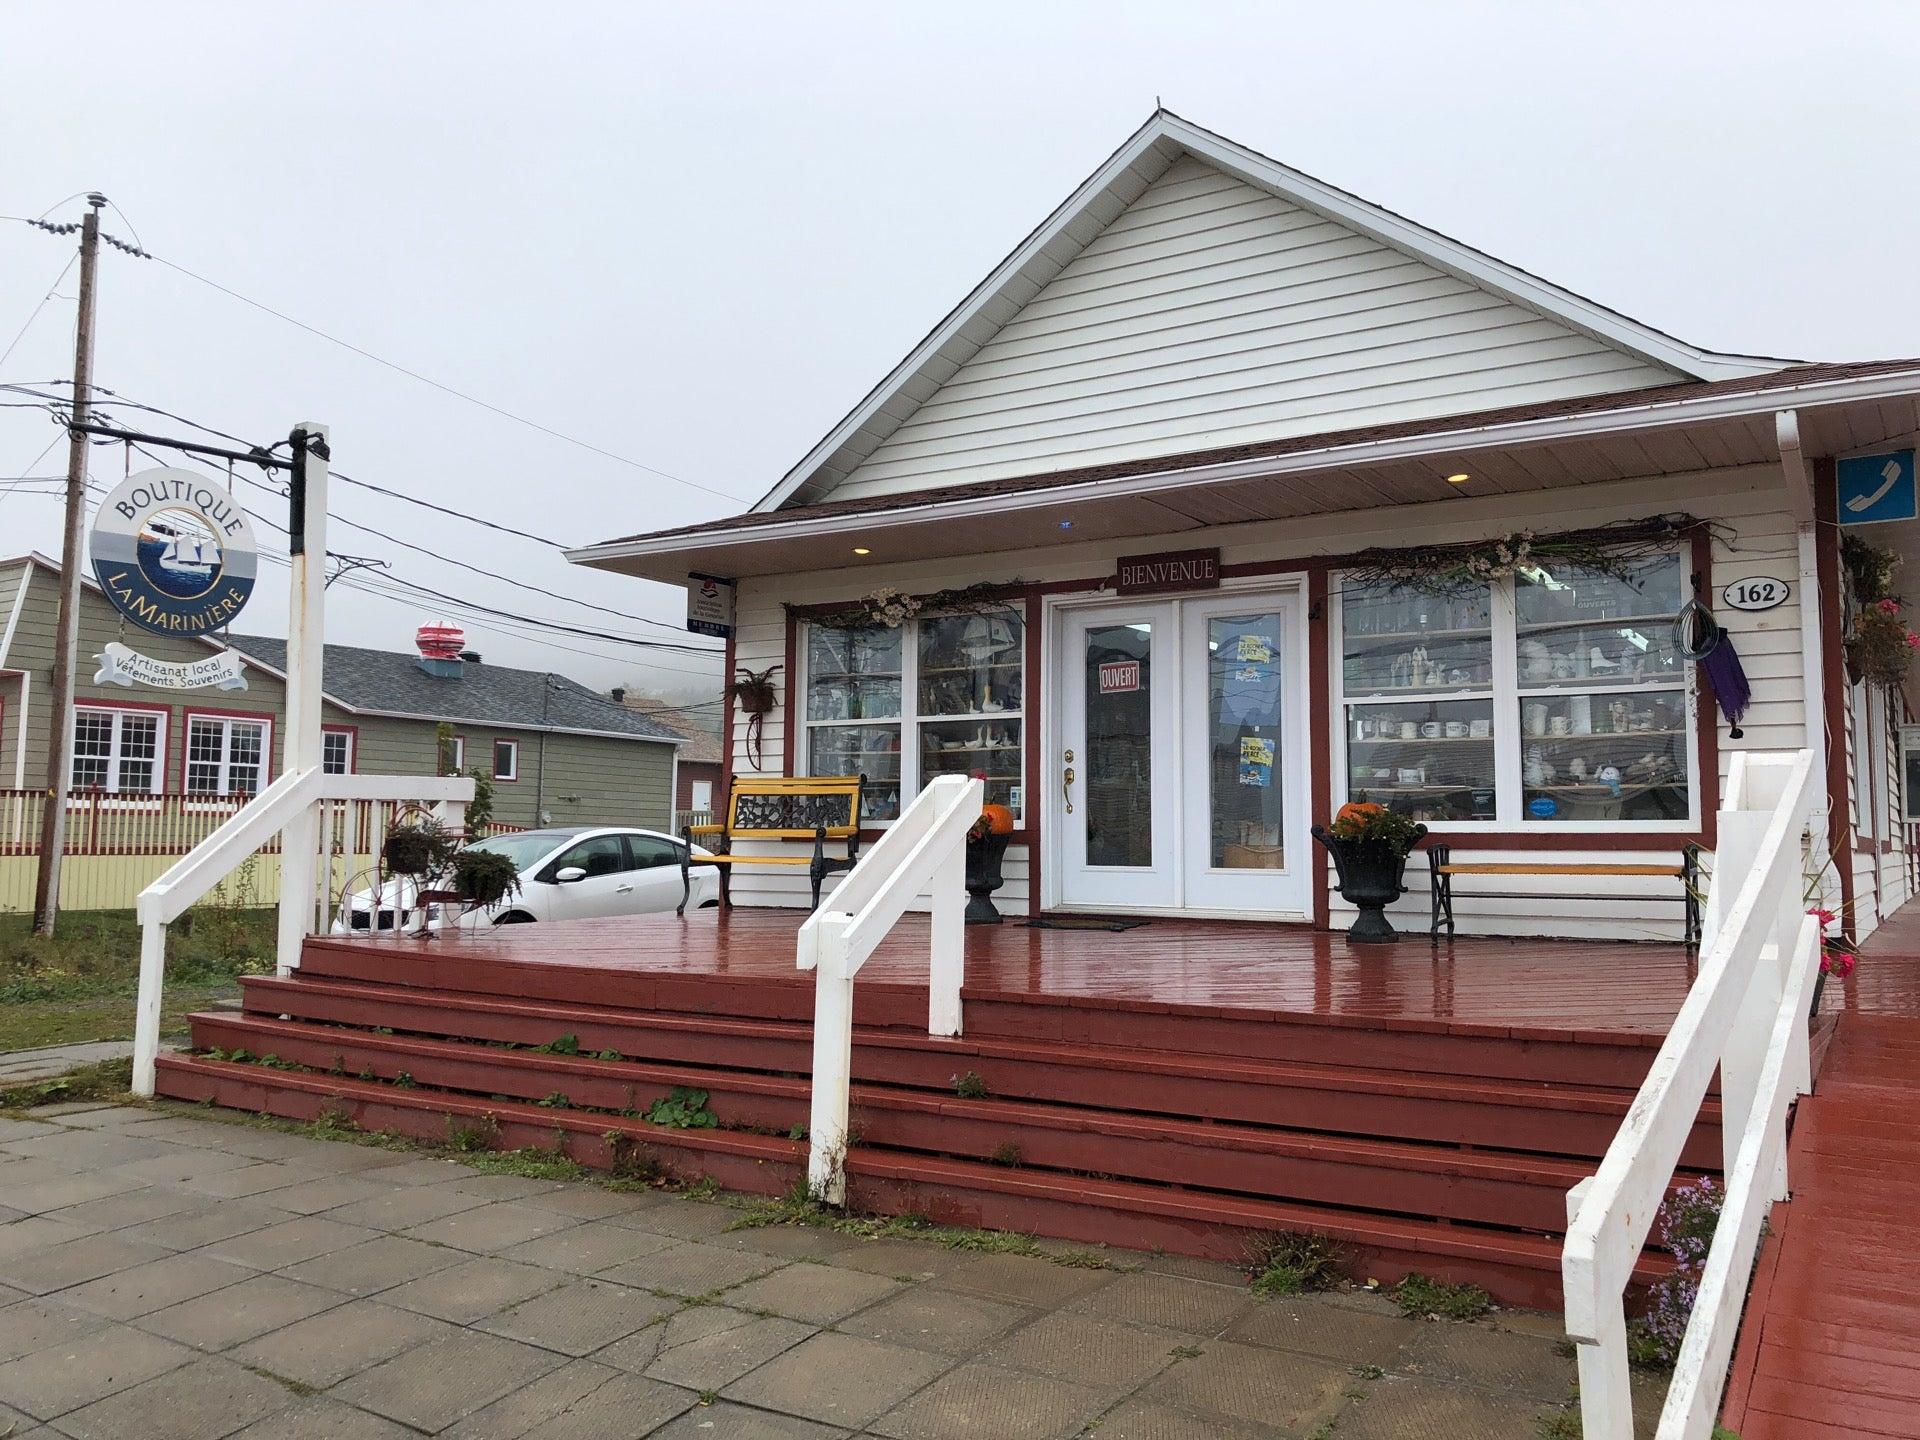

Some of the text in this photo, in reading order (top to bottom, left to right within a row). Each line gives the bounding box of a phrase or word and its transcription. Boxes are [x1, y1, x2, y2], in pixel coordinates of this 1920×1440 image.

[115, 480, 243, 537] BOUTIQUE
[1122, 558, 1214, 586] BIENVENUE
[1737, 583, 1775, 604] 162
[127, 653, 222, 677] Artisanat local
[180, 667, 234, 688] Souvenirs
[1101, 666, 1137, 688] OUVERT
